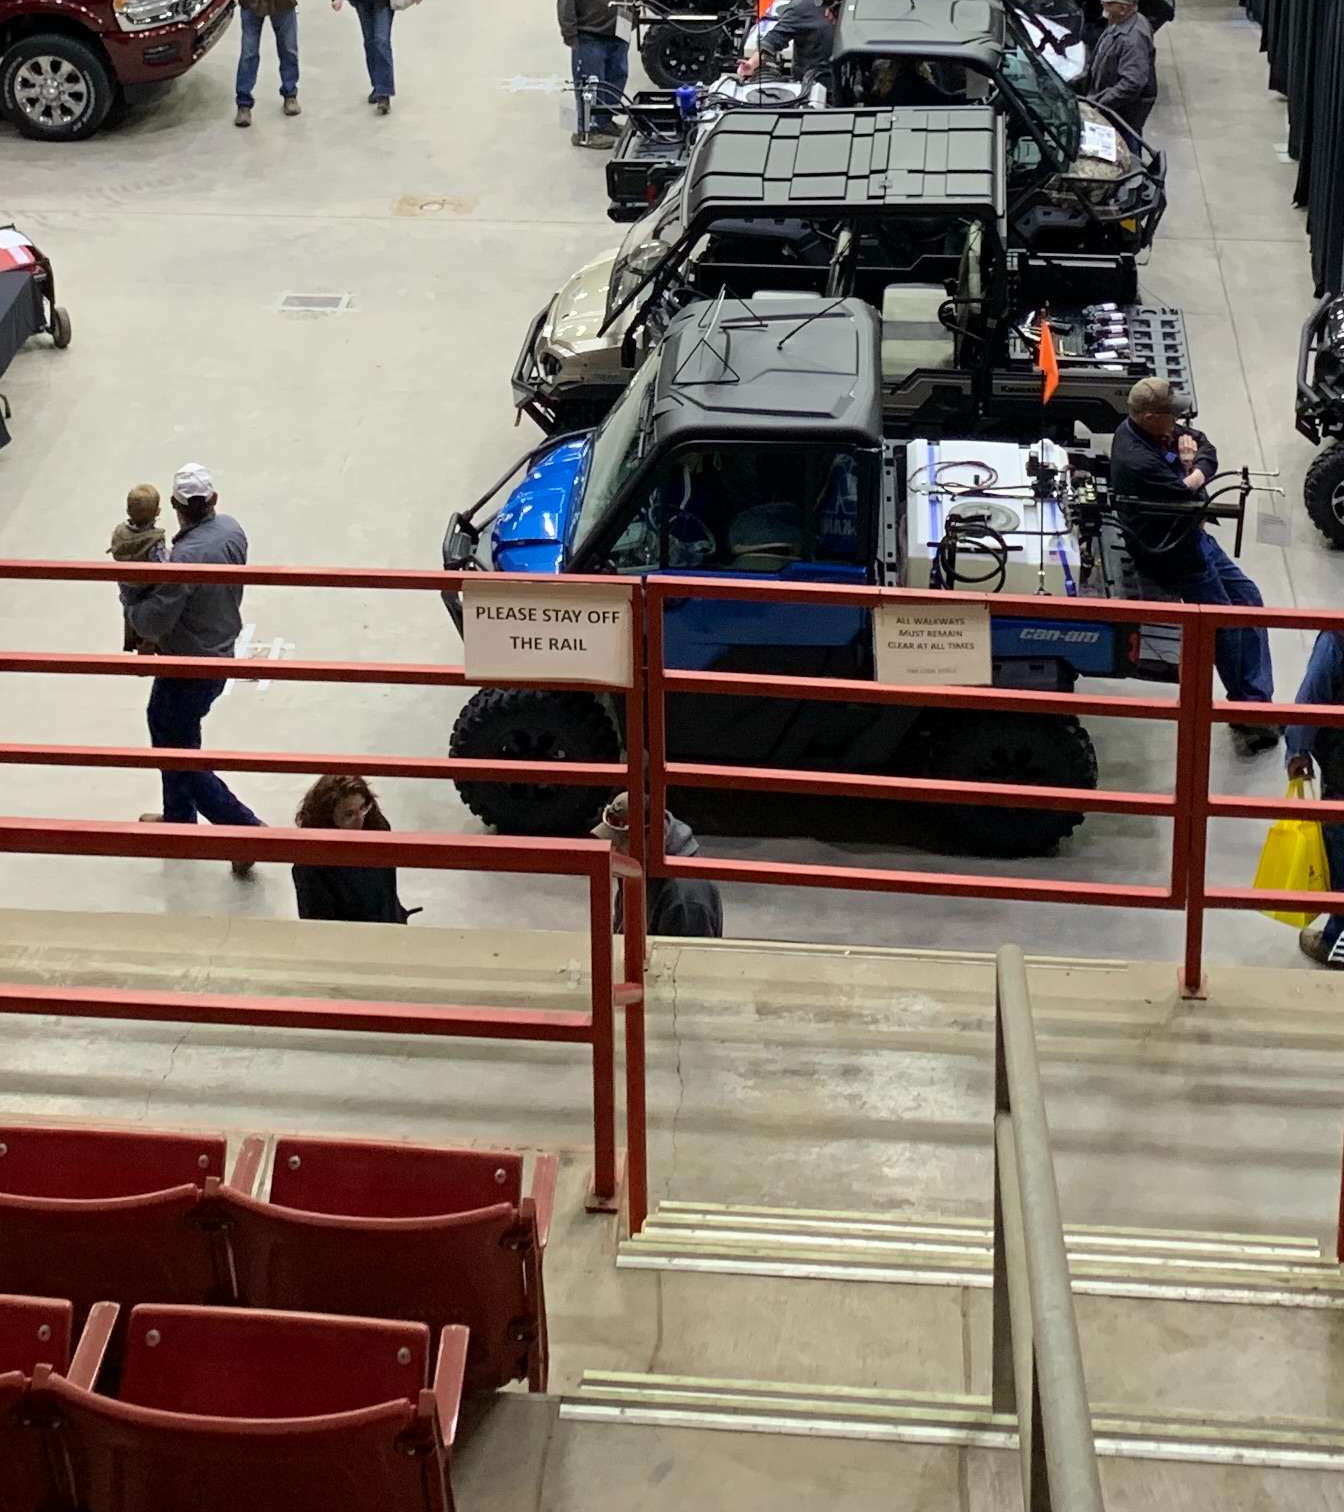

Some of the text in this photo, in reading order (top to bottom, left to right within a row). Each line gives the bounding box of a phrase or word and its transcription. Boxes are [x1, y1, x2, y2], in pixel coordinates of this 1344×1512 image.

[475, 605, 620, 625] PLEASE STAY OFF
[896, 617, 965, 626] ALL WALKWAYS
[899, 630, 963, 638] MUST REMAIN
[1019, 627, 1100, 643] can-am
[510, 635, 587, 653] THE RAIL
[888, 641, 975, 650] CLEAR AT ALL TIMES
